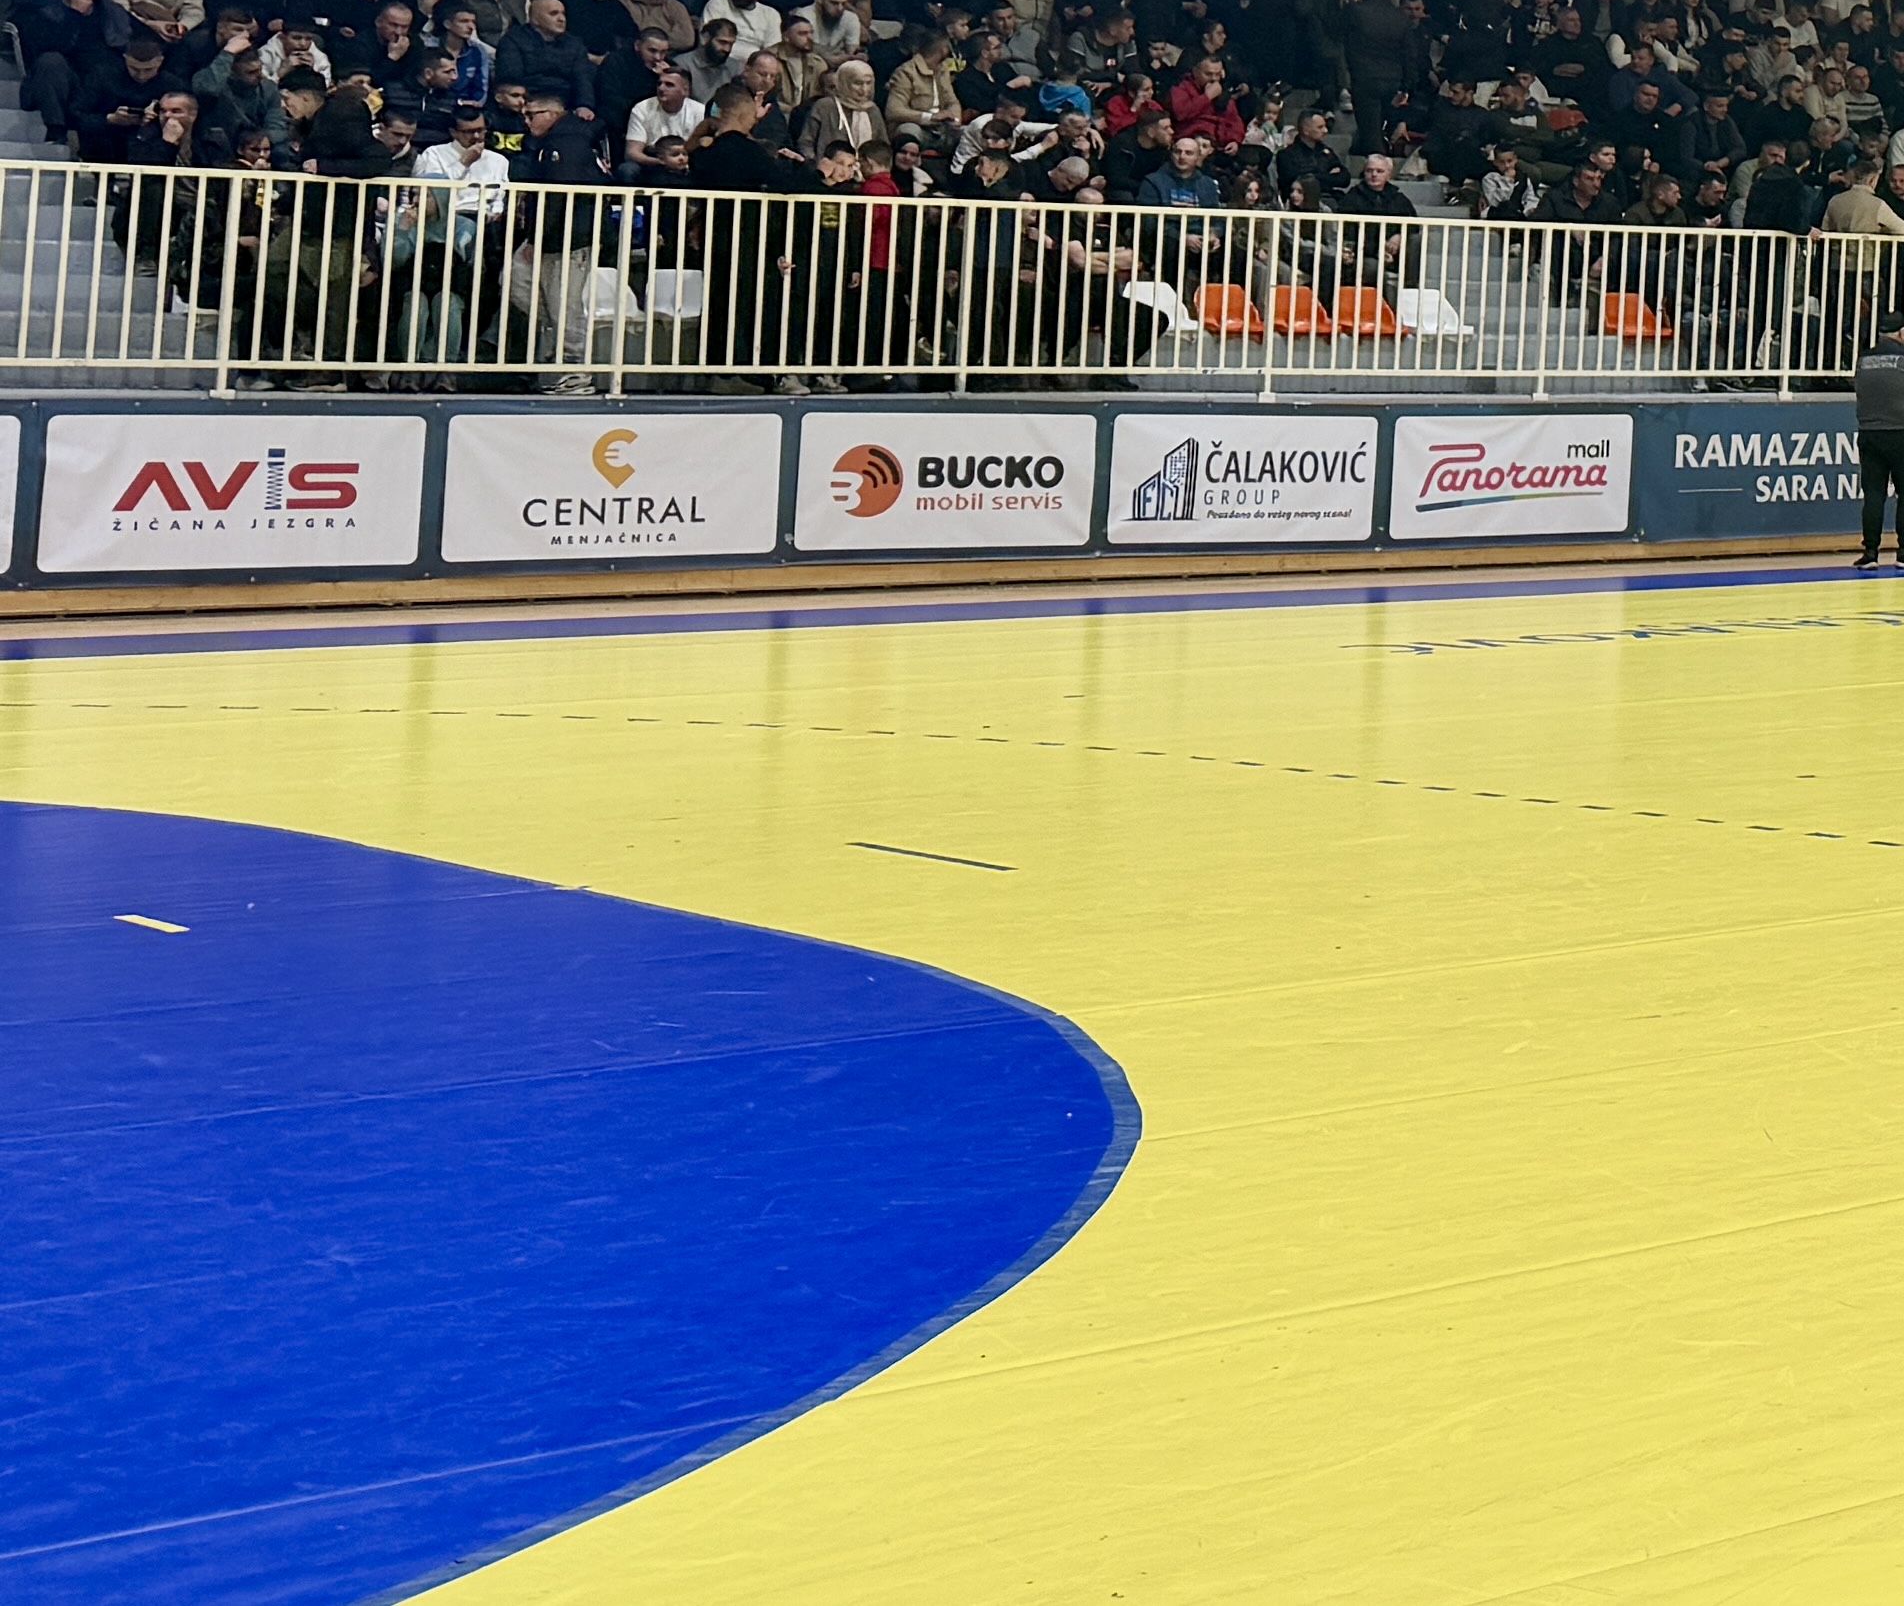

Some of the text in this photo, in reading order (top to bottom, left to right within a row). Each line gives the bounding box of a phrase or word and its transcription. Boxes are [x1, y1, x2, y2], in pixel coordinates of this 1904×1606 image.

[1205, 440, 1367, 484] ČALAKOVIĆ
[1674, 432, 1861, 469] RAMAZAN
[112, 448, 360, 511] AVIS
[917, 456, 1064, 488] BUCKO
[1419, 443, 1608, 498] Panorama
[916, 492, 1063, 511] mobil servis
[1203, 489, 1281, 505] GROUP
[1756, 473, 1831, 503] SARA
[112, 517, 356, 531] ŽIČANA JEZGRA
[522, 496, 706, 527] CENTRAL
[1253, 509, 1265, 519] do
[550, 532, 677, 546] MENJAČNICA
